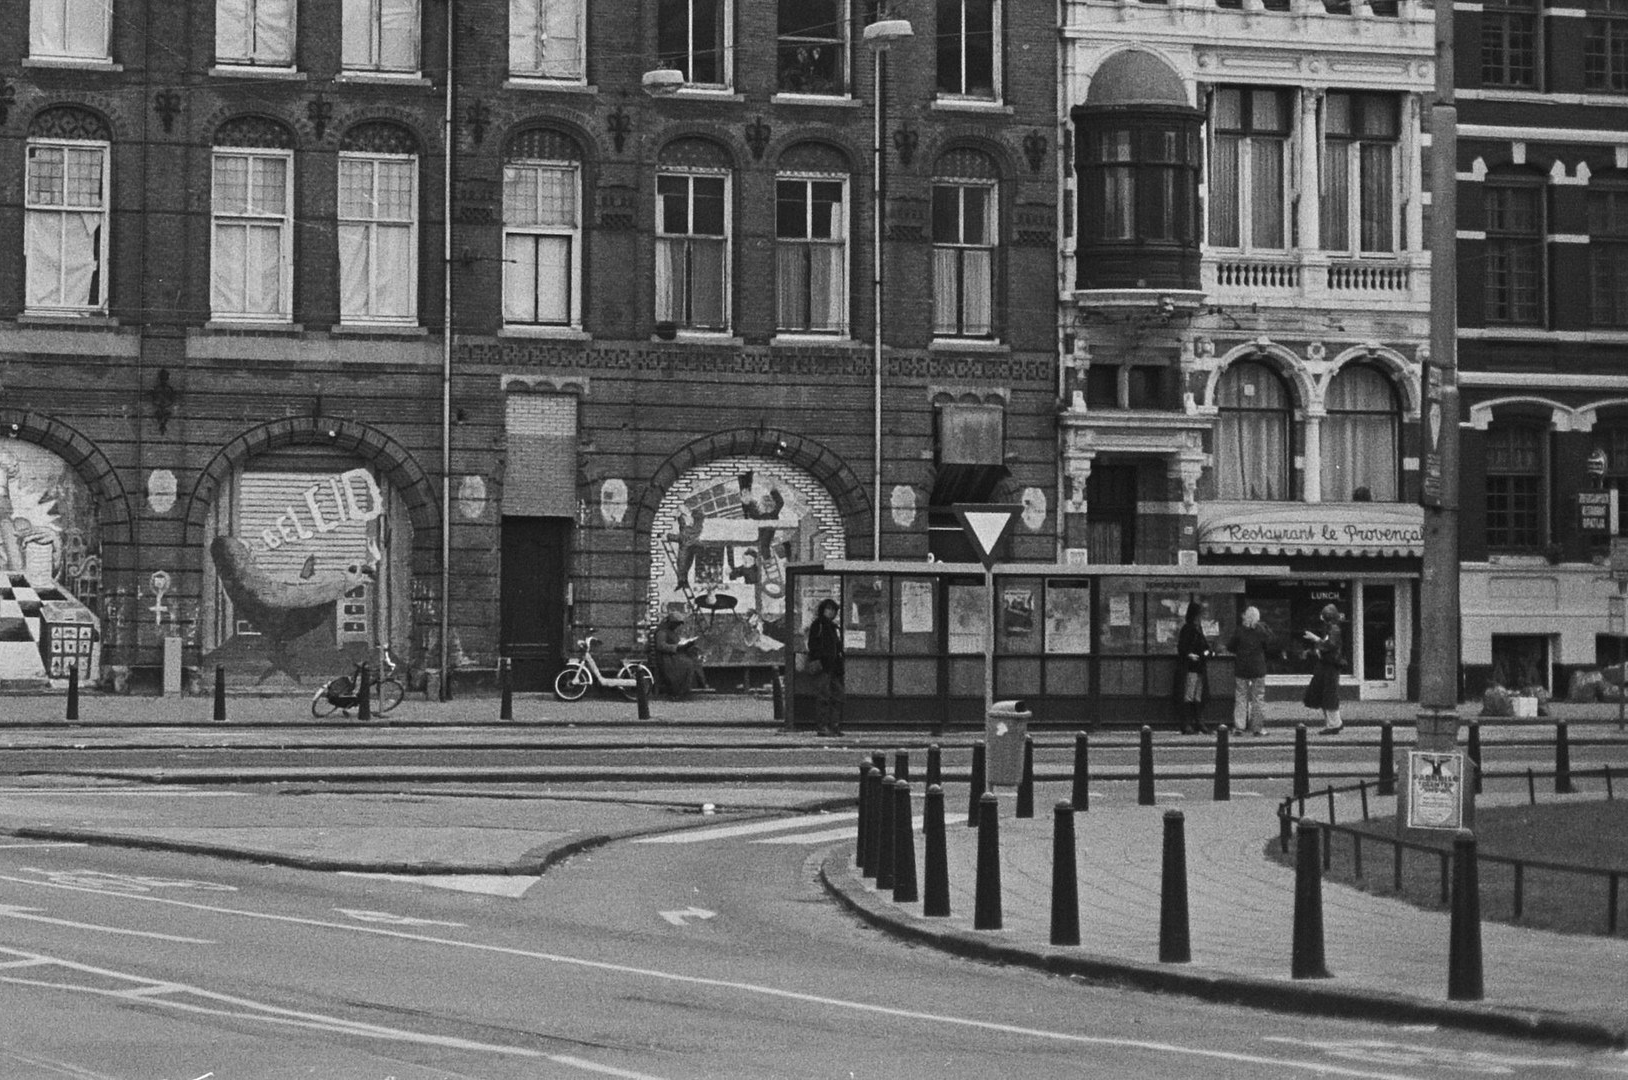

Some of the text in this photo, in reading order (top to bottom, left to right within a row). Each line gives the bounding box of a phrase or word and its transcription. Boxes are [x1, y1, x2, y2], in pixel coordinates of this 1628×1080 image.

[262, 468, 385, 549] BELEID
[1224, 524, 1315, 541] Restaurant
[1322, 524, 1338, 540] le
[1311, 591, 1340, 600] LUNCH
